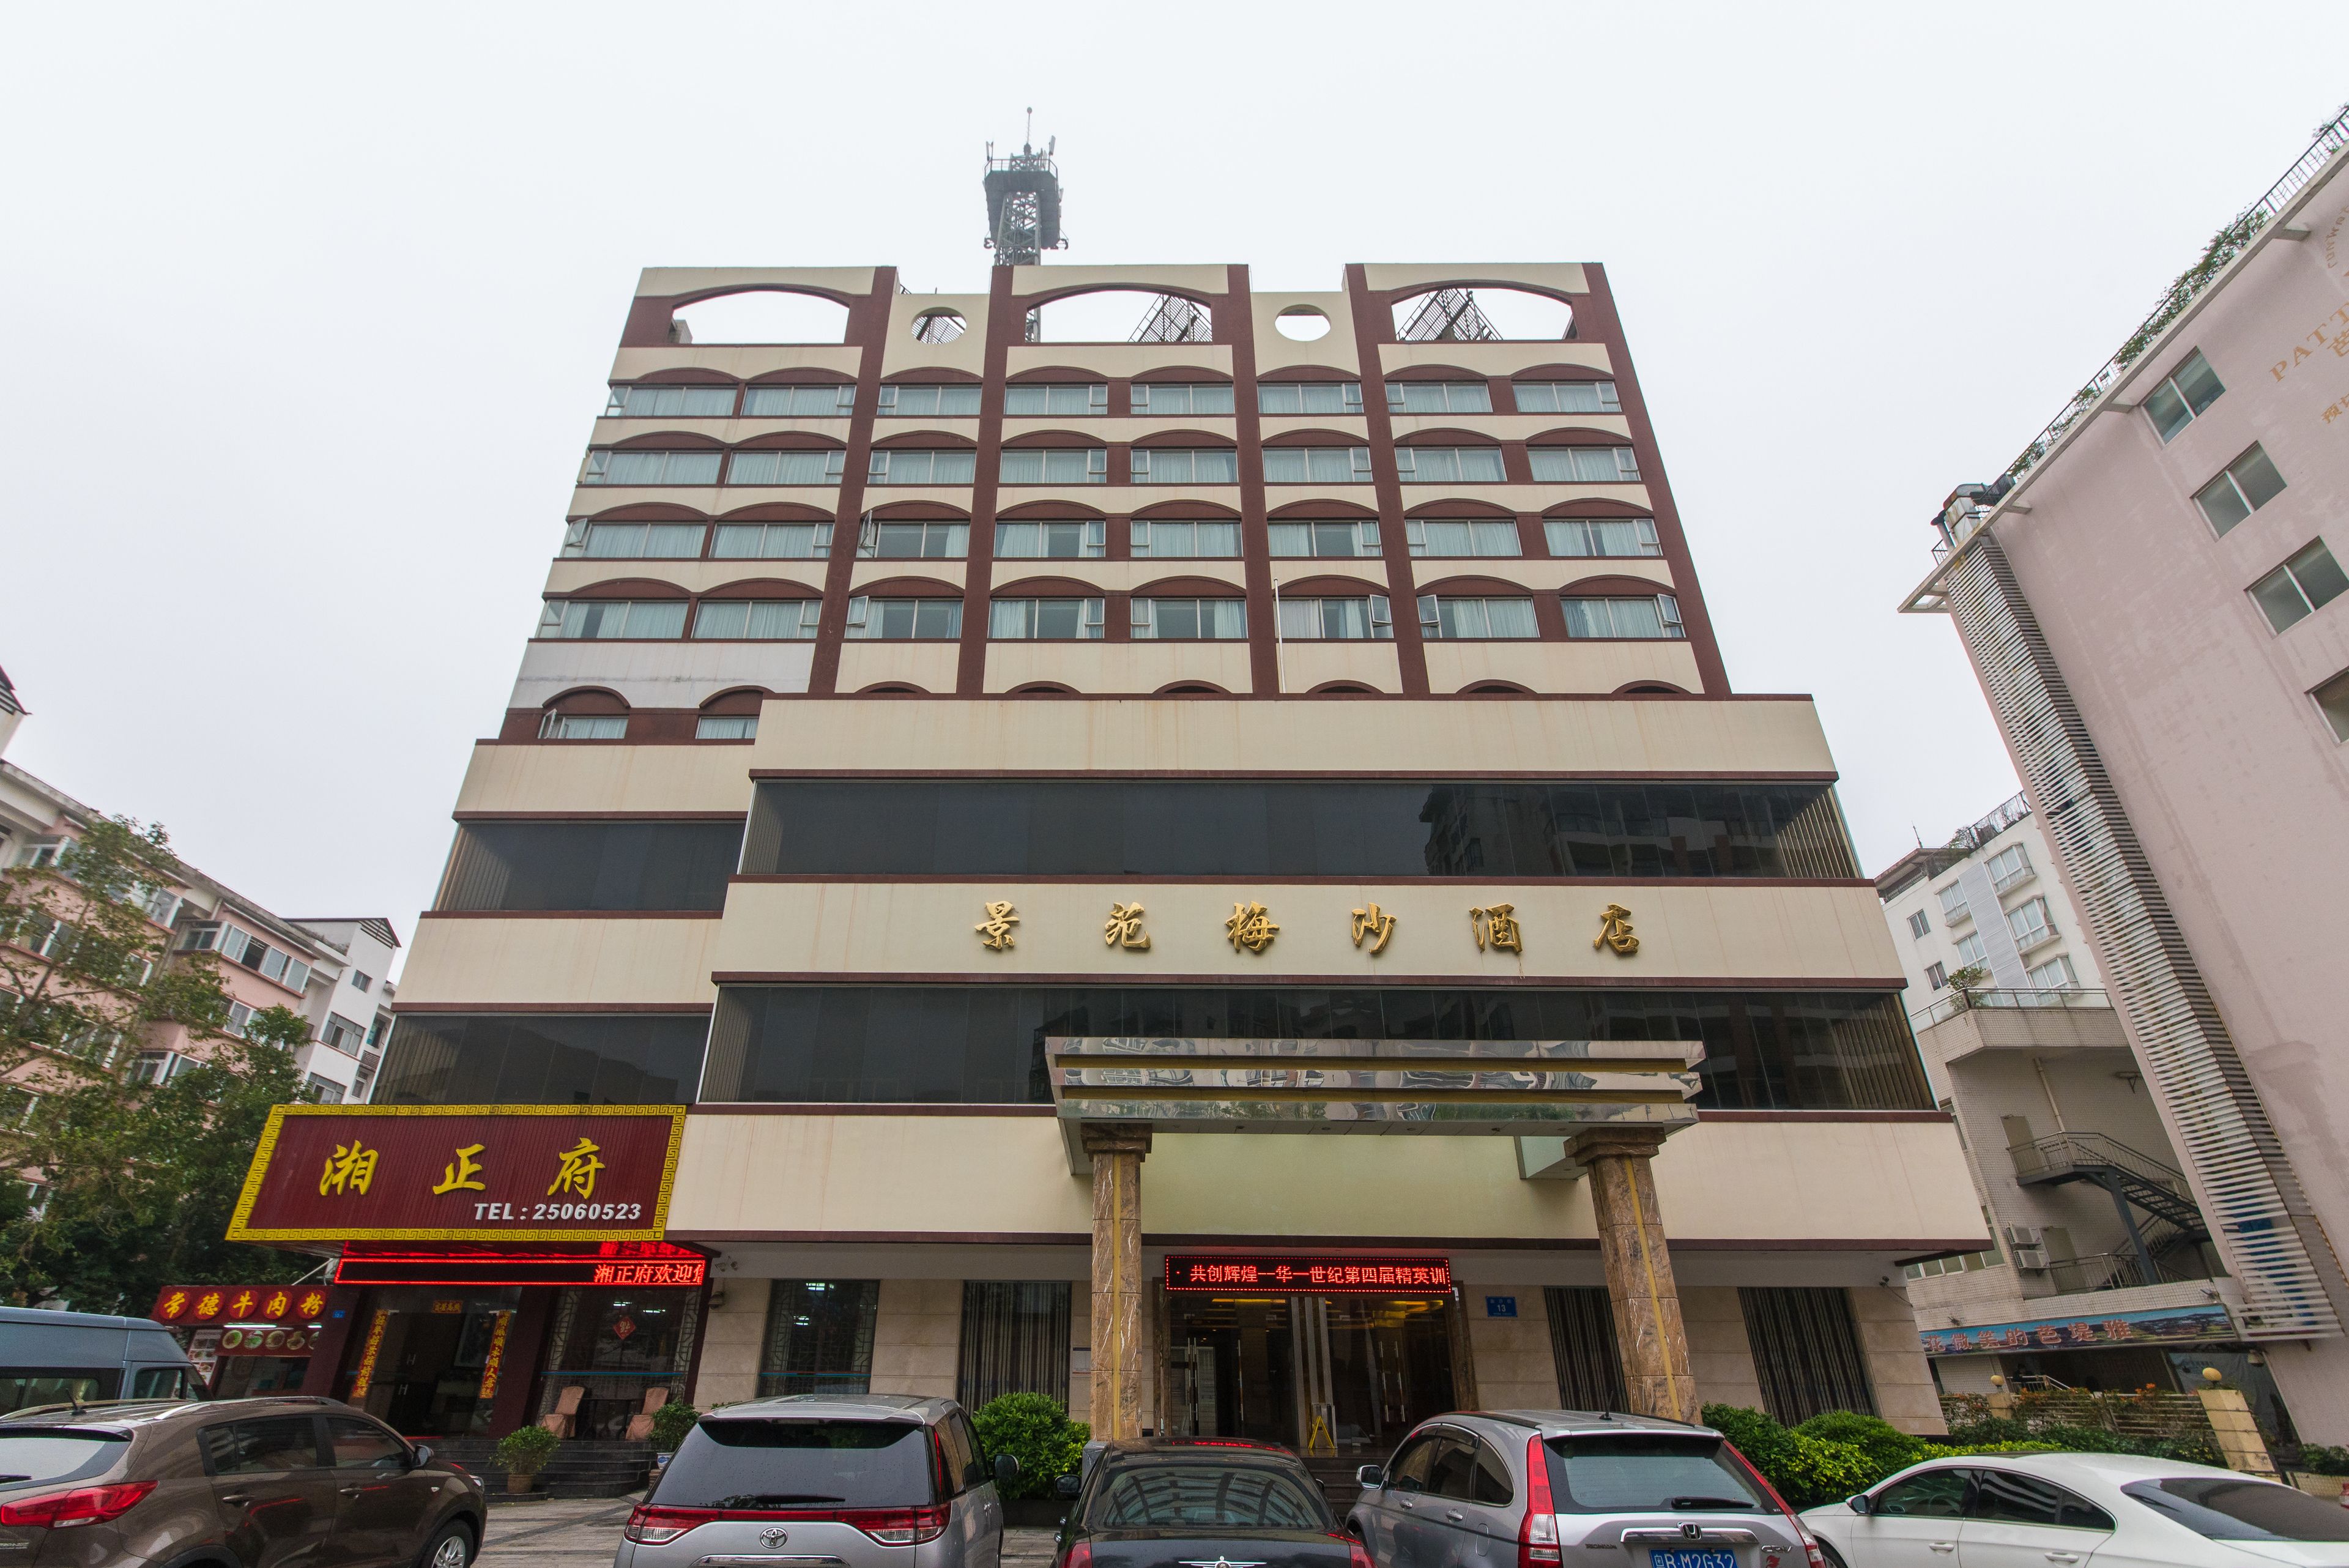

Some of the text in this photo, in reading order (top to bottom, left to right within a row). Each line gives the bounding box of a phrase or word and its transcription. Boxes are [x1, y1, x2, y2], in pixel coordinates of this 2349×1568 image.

[319, 1138, 605, 1200] 湘正府
[164, 1291, 323, 1318] 常德牛肉粉
